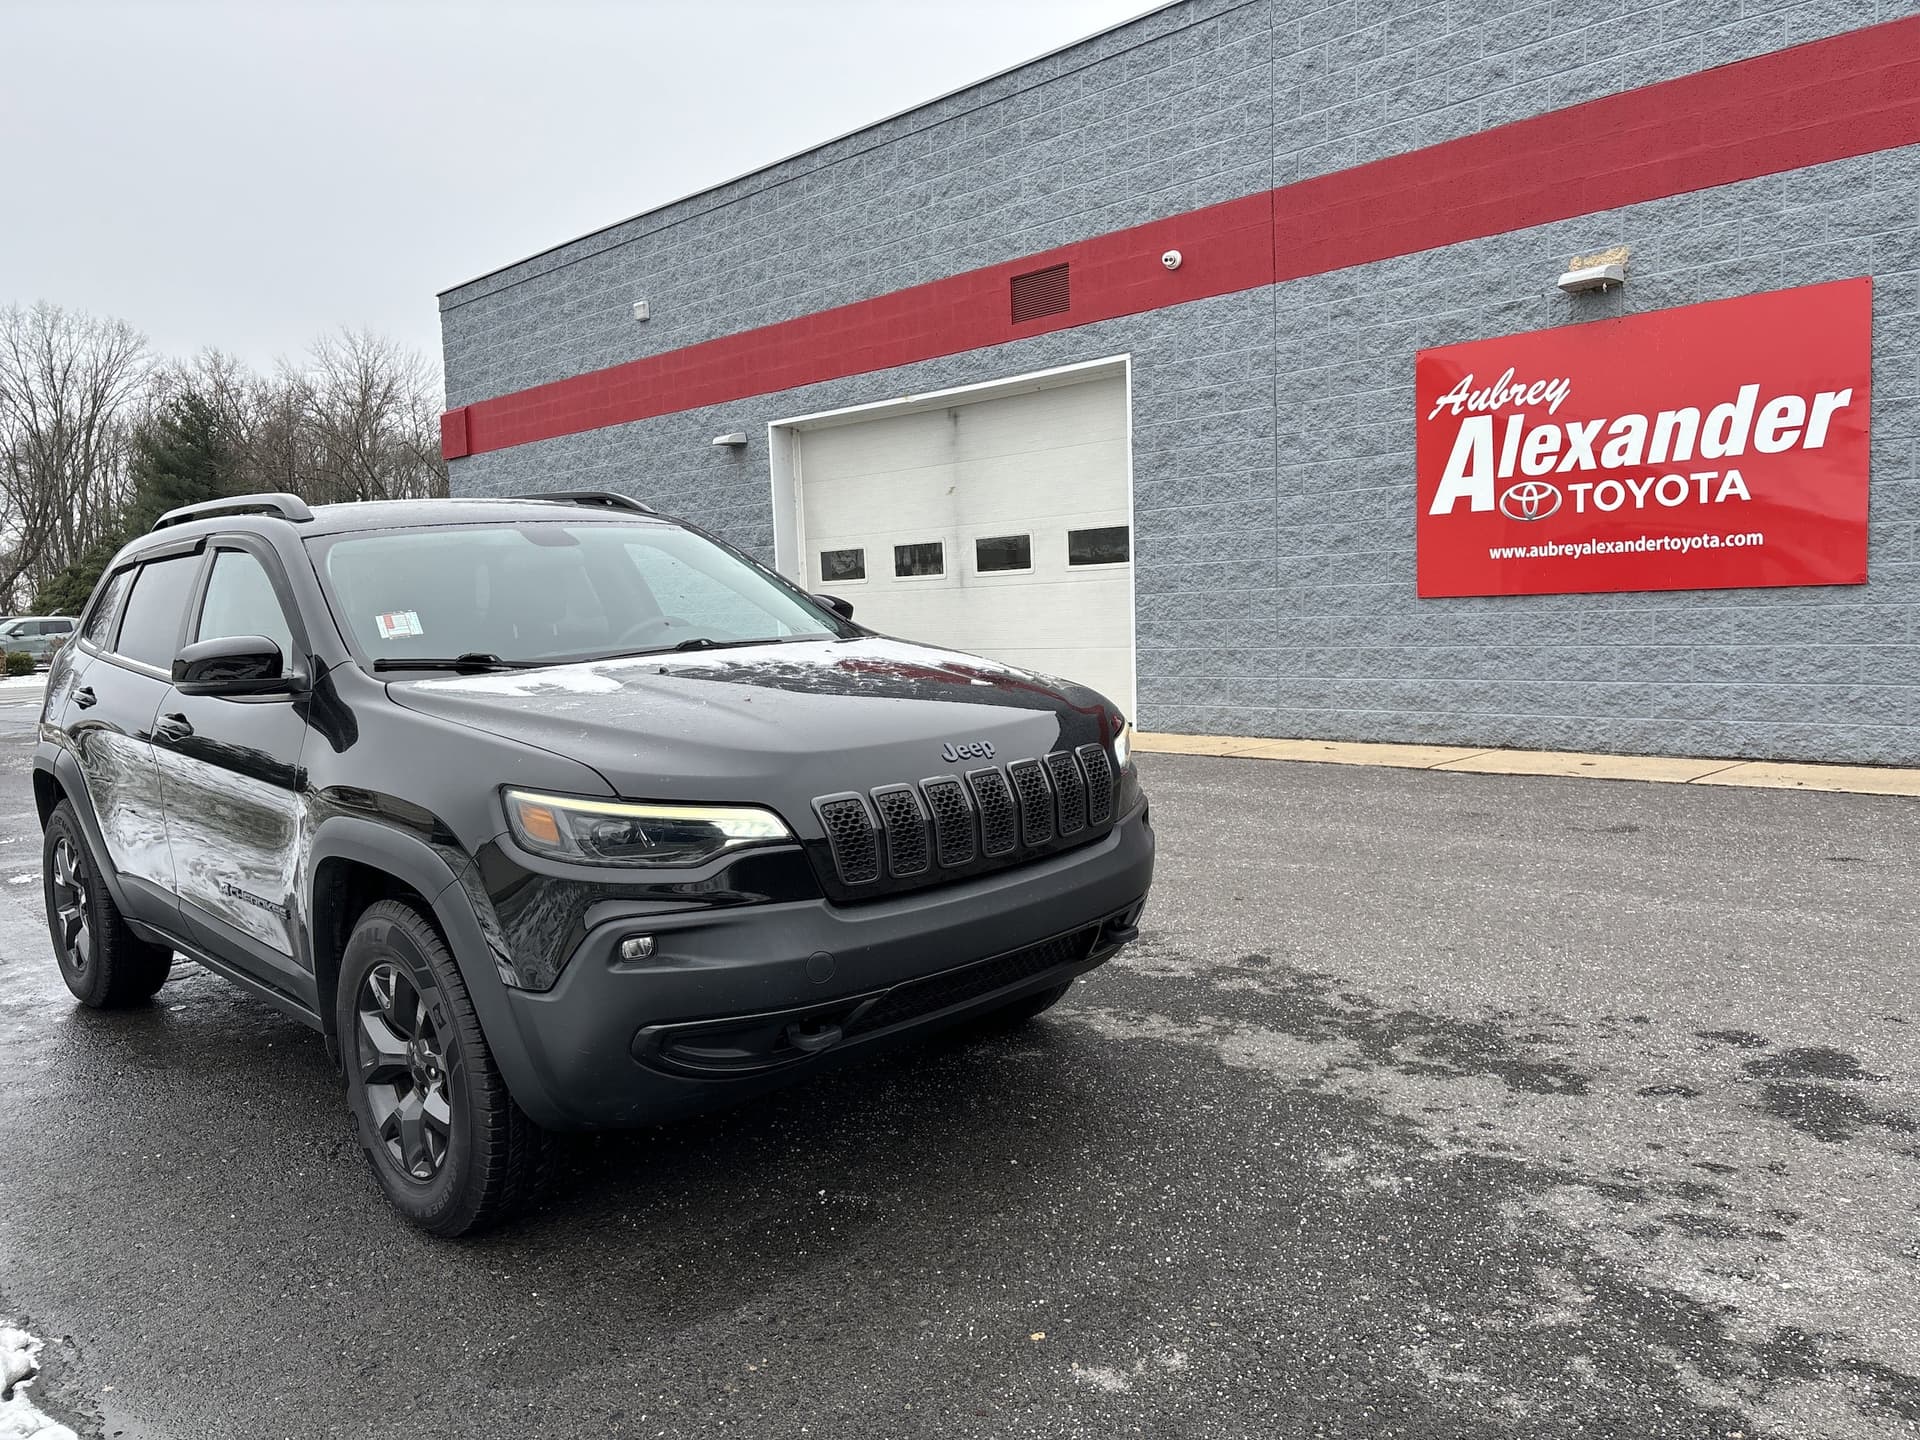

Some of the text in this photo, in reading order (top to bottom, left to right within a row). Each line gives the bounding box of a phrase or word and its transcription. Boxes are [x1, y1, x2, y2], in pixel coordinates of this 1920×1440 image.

[1427, 366, 1571, 421] Aubrey
[1428, 383, 1853, 516] Alexander
[1567, 469, 1752, 513] TOYOTA
[1489, 532, 1764, 560] www.aubreyalexandertoyota.com
[941, 740, 996, 763] Jeep
